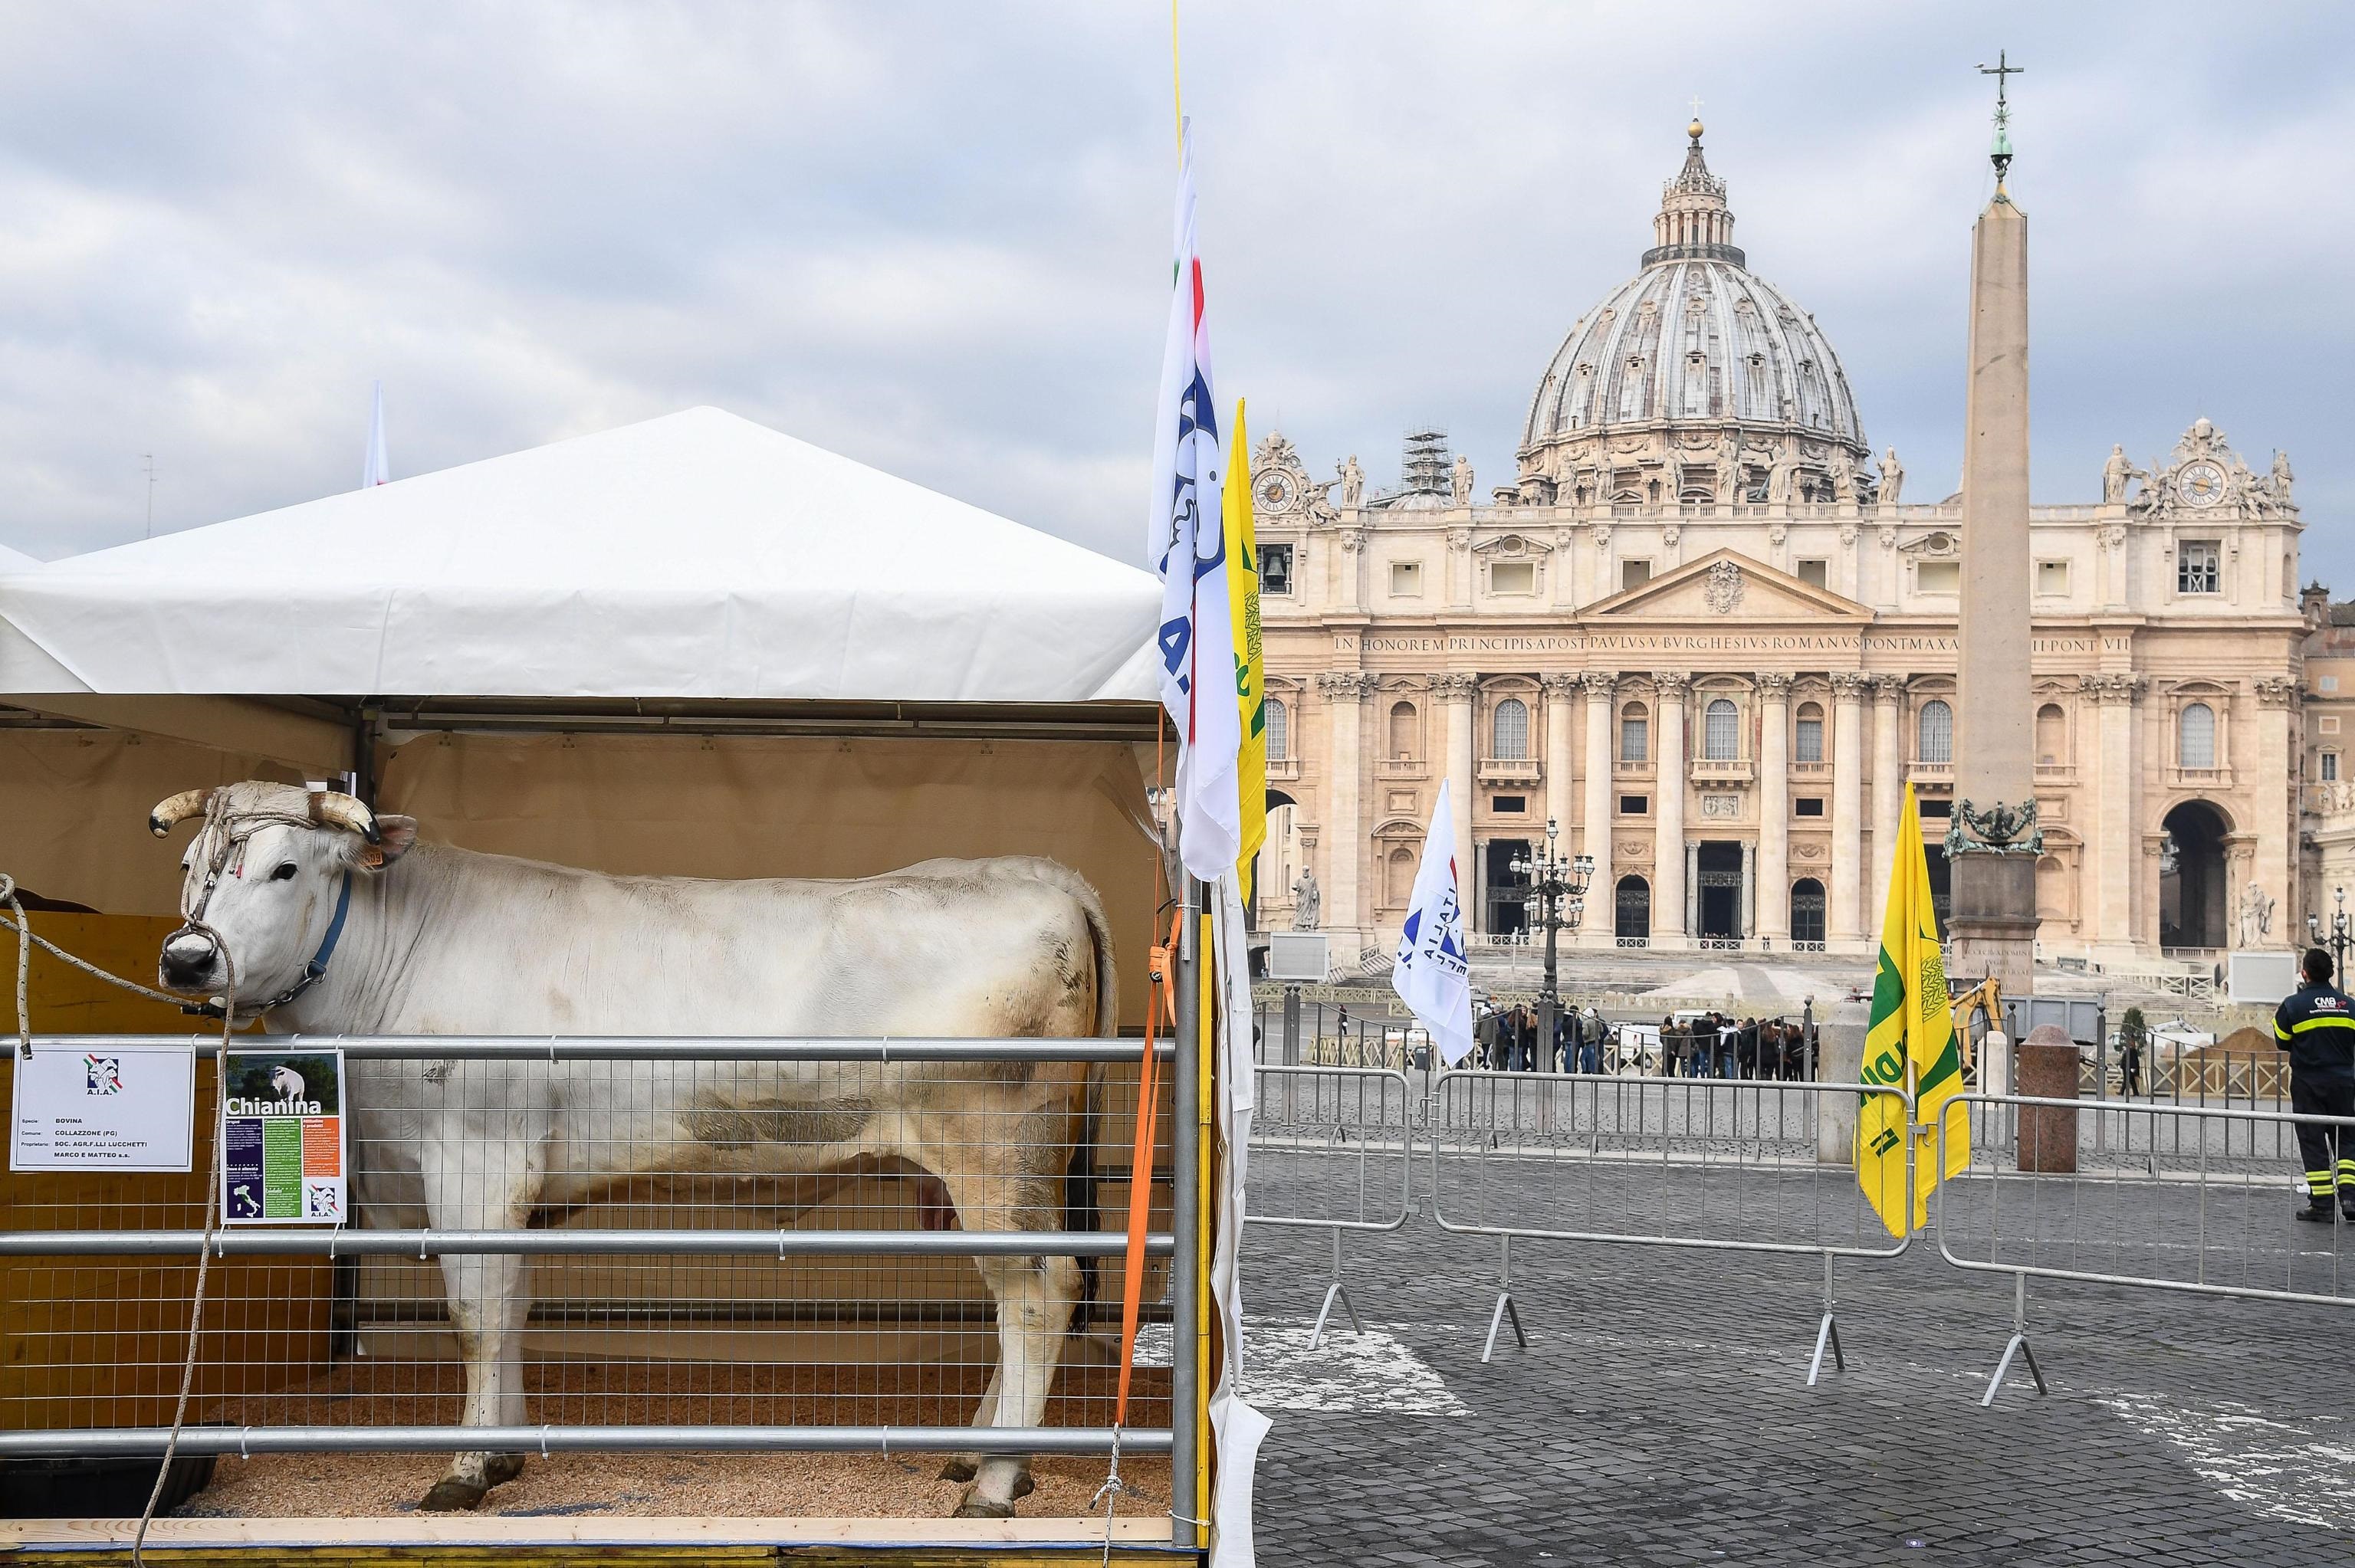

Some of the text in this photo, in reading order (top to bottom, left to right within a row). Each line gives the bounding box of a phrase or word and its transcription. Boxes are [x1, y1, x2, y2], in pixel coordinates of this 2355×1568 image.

[1335, 638, 1353, 649] IN
[1361, 639, 1444, 651] HONOREM
[1450, 638, 1532, 650] PRINCIPIS
[1536, 638, 1587, 650] APOST
[1591, 637, 1645, 648] PAVLVS
[1650, 637, 1658, 648] V
[1664, 637, 1767, 649] BVRGHESIVS
[1773, 637, 1859, 649] ROMANVS
[1864, 638, 1907, 650] PONT
[2051, 640, 2097, 651] PONT
[2104, 638, 2127, 650] VII
[2314, 997, 2337, 1006] CMB
[225, 1097, 321, 1115] Chianina
